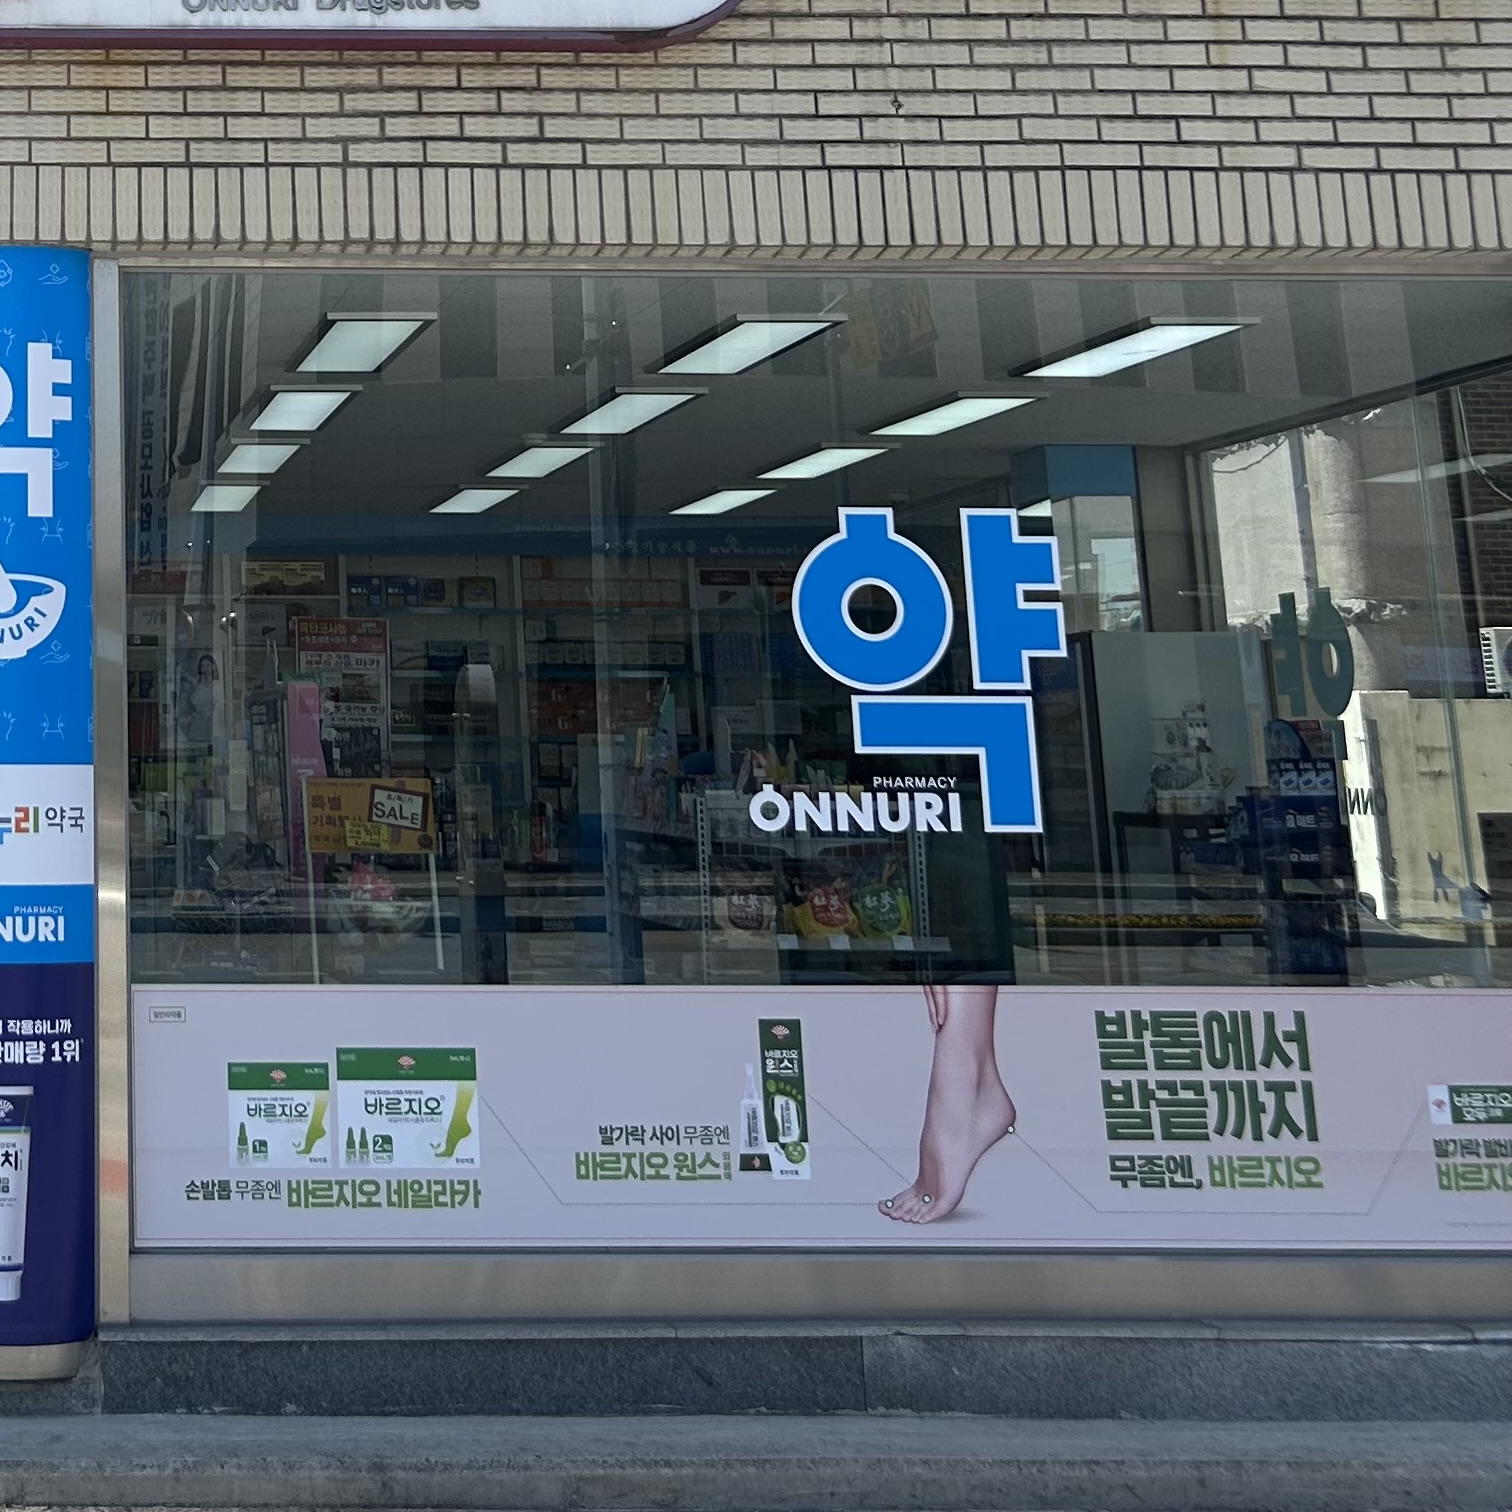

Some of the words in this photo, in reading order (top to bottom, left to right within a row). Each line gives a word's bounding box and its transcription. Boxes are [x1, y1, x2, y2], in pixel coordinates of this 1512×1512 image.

[792, 506, 1068, 833] 약
[872, 776, 957, 789] PHARMACY
[373, 801, 421, 826] SALE
[748, 783, 963, 833] ONNURI
[13, 905, 64, 914] PHARMACY
[1094, 1009, 1312, 1072] 발톱에서
[246, 1101, 309, 1119] 바르지오
[364, 1096, 443, 1117] 바르지오
[1100, 1079, 1319, 1142] 발끝까지
[598, 1124, 646, 1147] 발가락
[649, 1124, 680, 1146] 사이
[682, 1124, 730, 1147] 무좀엔
[574, 1151, 670, 1181] 바르지오
[673, 1151, 722, 1181] 원스
[1108, 1154, 1203, 1190] 무좀엔,
[1207, 1154, 1324, 1189] 바르지오
[184, 1179, 233, 1202] 손발톱
[234, 1179, 282, 1202] 무좀엔
[287, 1178, 382, 1209] 바르지오
[386, 1178, 482, 1209] 네일라카
